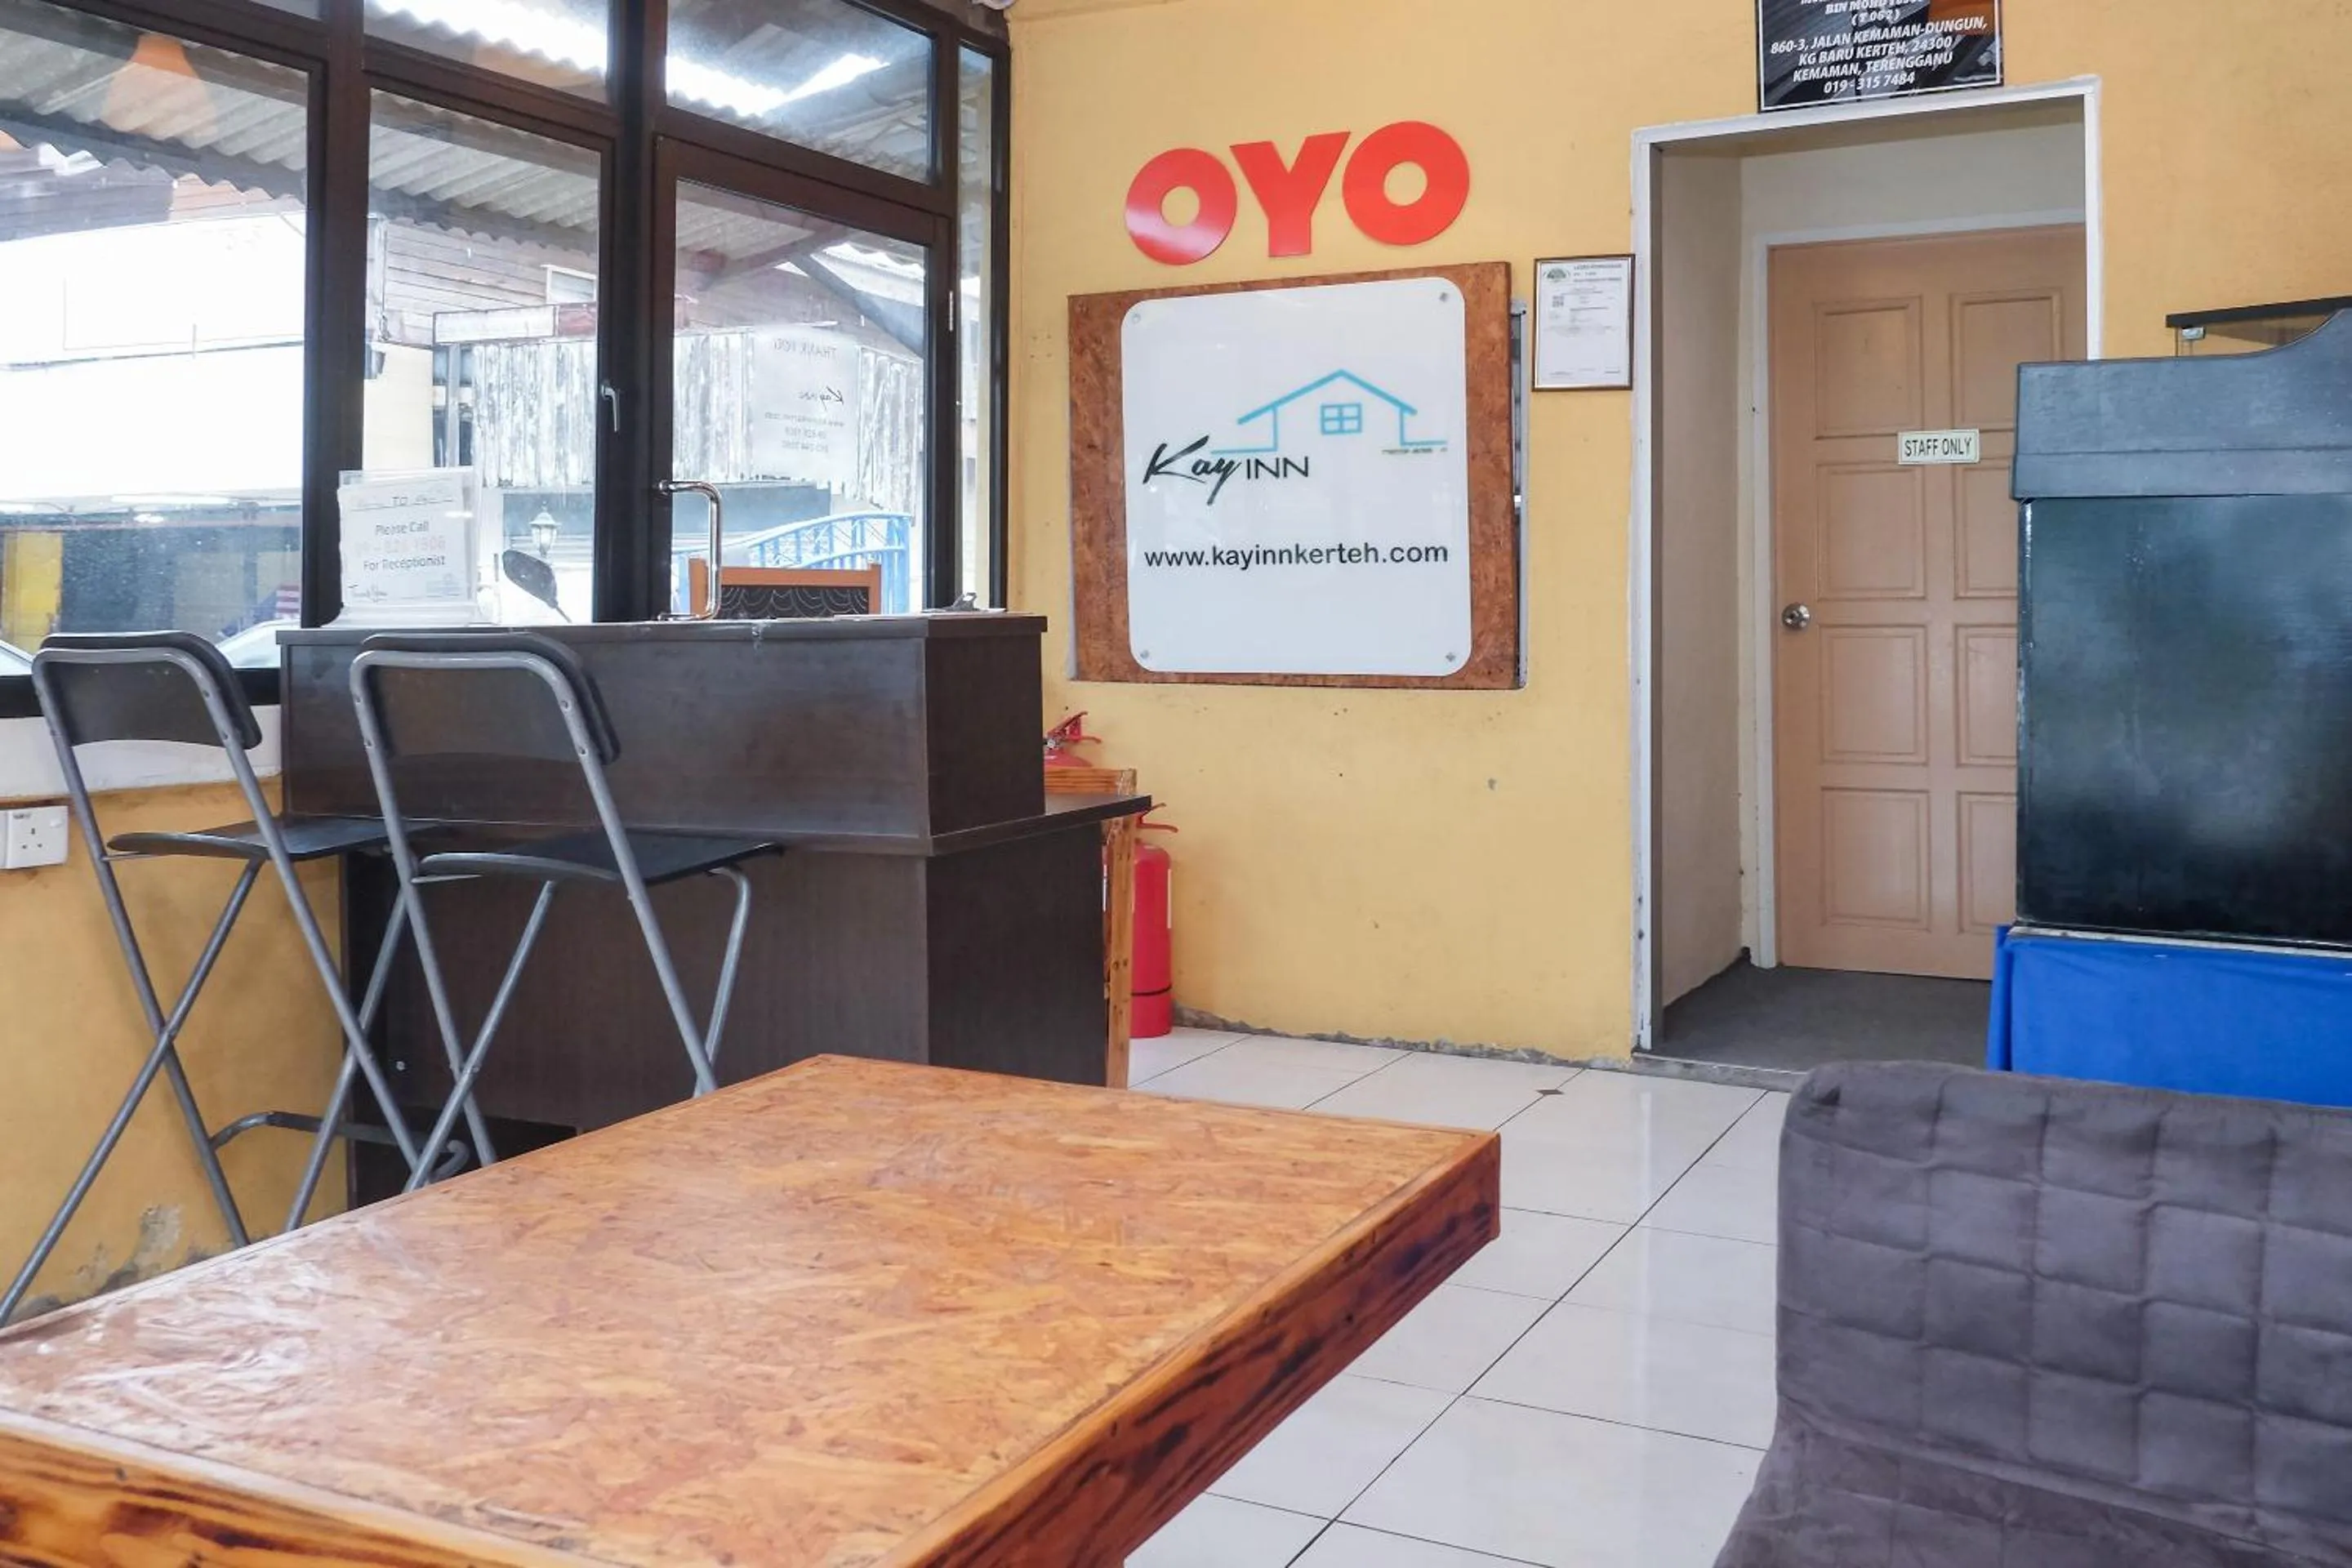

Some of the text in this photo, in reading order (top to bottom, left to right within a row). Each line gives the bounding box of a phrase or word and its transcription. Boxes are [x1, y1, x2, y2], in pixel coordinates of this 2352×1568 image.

[1771, 16, 1988, 54] 860-3, JALAN KEMAMAN-DUNGUN,
[1798, 52, 1817, 66] KG
[1818, 47, 1854, 64] BARU
[1911, 35, 1953, 51] 24300
[1793, 51, 1953, 82] KEMAMAN, TERENGGANU
[1856, 76, 1880, 91] 315
[1883, 71, 1915, 87] 7484
[1125, 121, 1470, 266] OYO
[1904, 437, 1972, 457] STAFF ONLY
[1246, 455, 1309, 480] INN
[374, 520, 430, 536] Please Call
[363, 555, 446, 572] For Receptionist
[1144, 542, 1449, 571] www.kayinnkerteh.com
